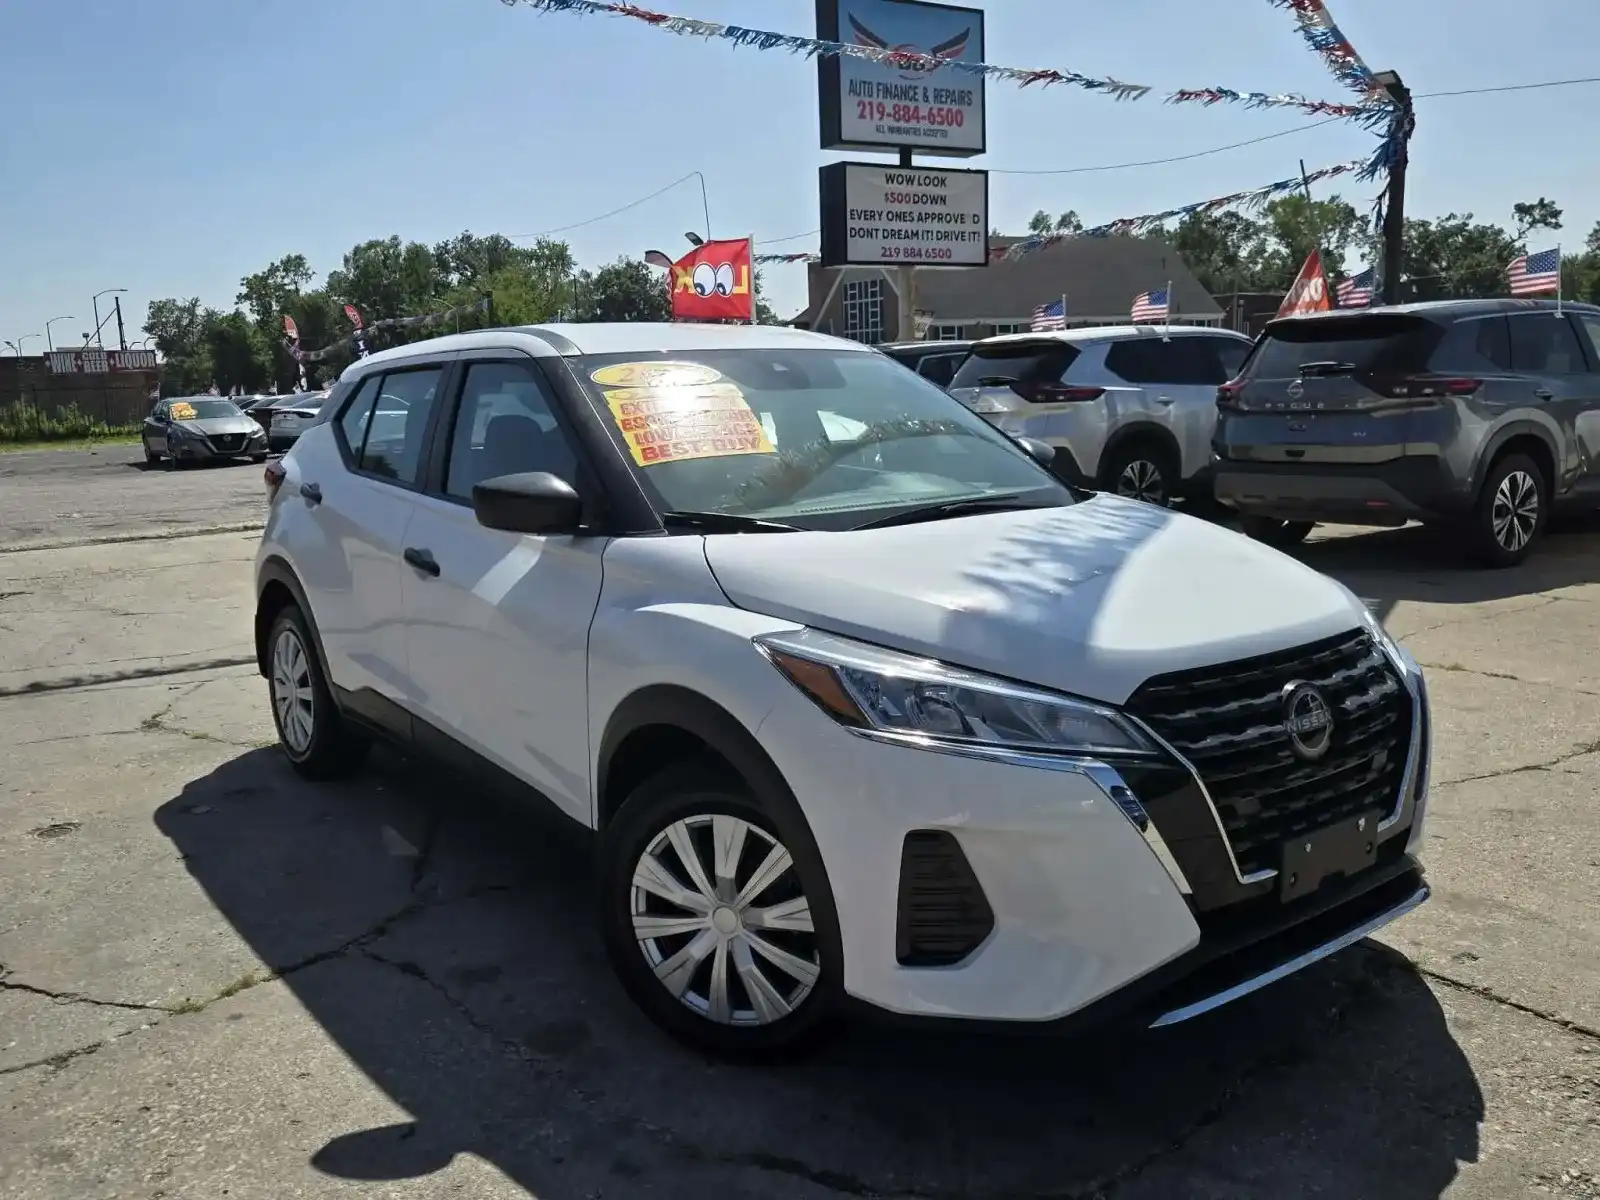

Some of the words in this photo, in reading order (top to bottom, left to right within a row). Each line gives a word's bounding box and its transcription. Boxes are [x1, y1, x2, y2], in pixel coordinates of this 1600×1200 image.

[848, 79, 873, 98] AUTO
[876, 82, 919, 102] FINANCE
[922, 86, 930, 103] &
[934, 87, 973, 107] REPAIRS
[857, 100, 964, 127] 219-884-6500
[885, 173, 915, 186] WOW
[918, 175, 947, 188] LOOK
[884, 192, 911, 204] $500
[913, 194, 947, 206] DOWN
[850, 209, 883, 222] EVERY
[886, 210, 915, 223] ONES
[849, 227, 880, 239] DONT
[882, 229, 919, 241] DREAM
[921, 230, 934, 241] IT!
[936, 230, 967, 242] DRIVE
[968, 231, 980, 242] IT!
[881, 246, 900, 258] 219
[903, 247, 922, 259] 884
[925, 248, 952, 259] 6500
[50, 352, 78, 373] WINE
[83, 360, 109, 373] BEER
[114, 352, 156, 370] LIQUOR
[640, 442, 706, 462] BEST
